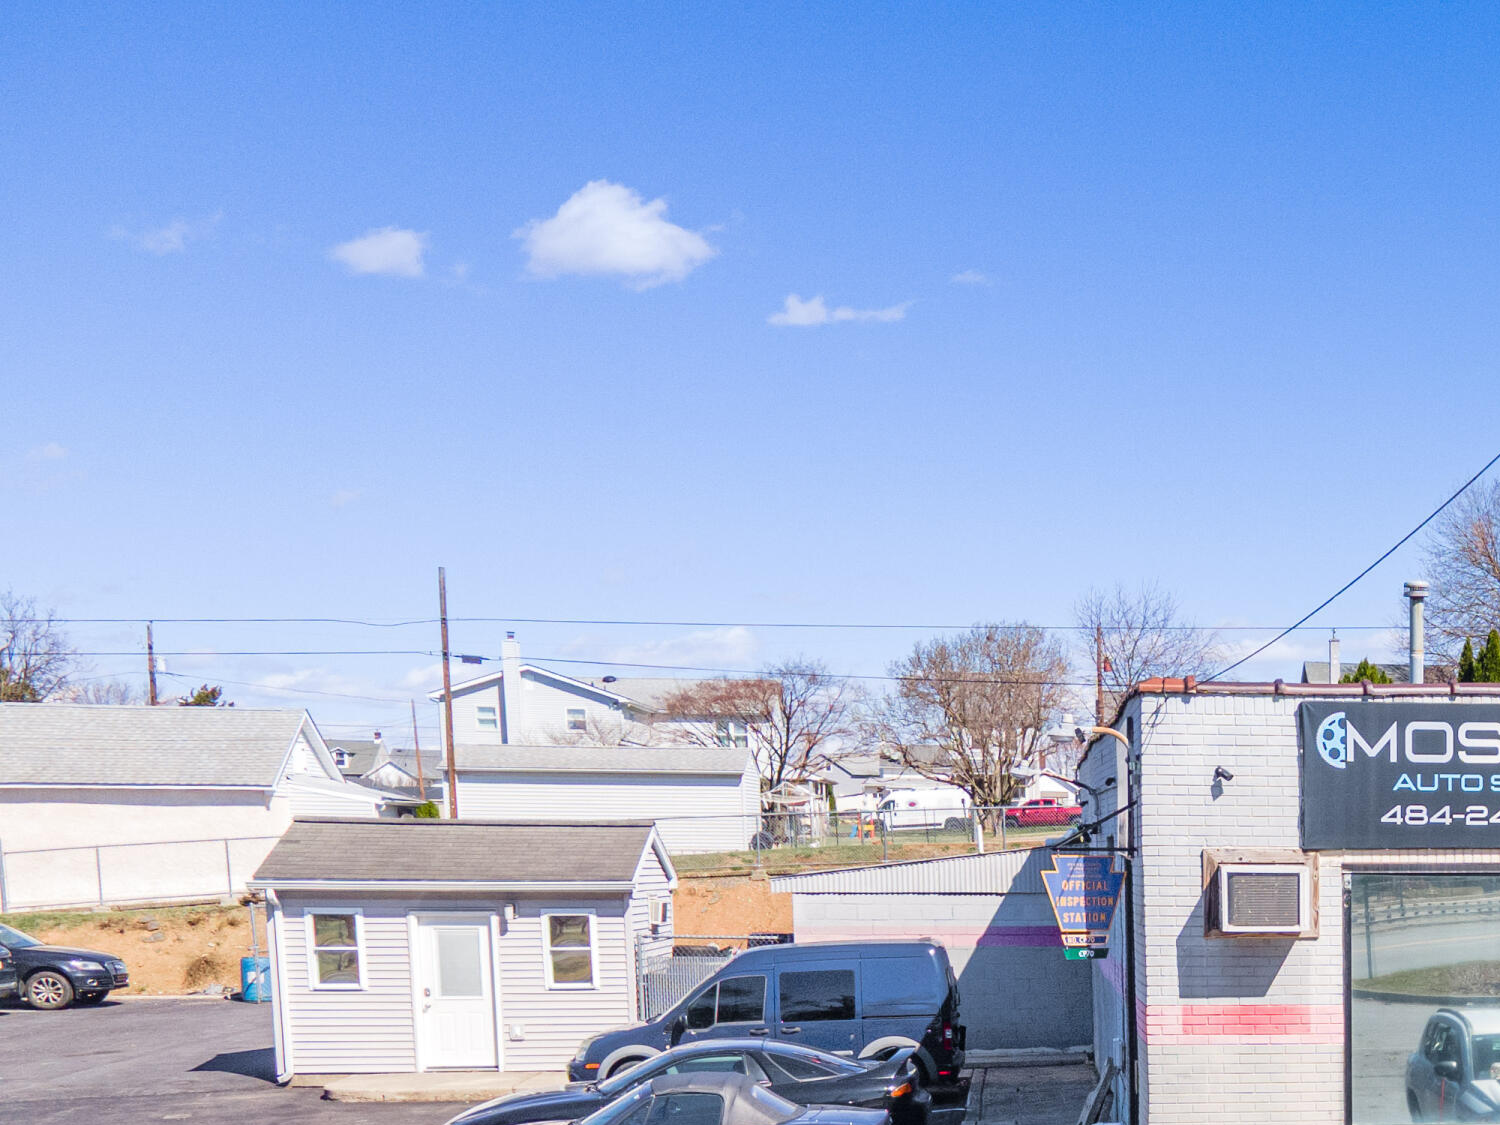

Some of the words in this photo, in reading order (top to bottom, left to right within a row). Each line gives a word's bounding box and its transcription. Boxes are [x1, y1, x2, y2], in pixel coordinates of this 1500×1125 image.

[1393, 774, 1483, 792] AUTO
[1061, 880, 1108, 891] OFFICIAL
[1056, 896, 1114, 907] INSPECTION
[1063, 912, 1107, 923] STATION
